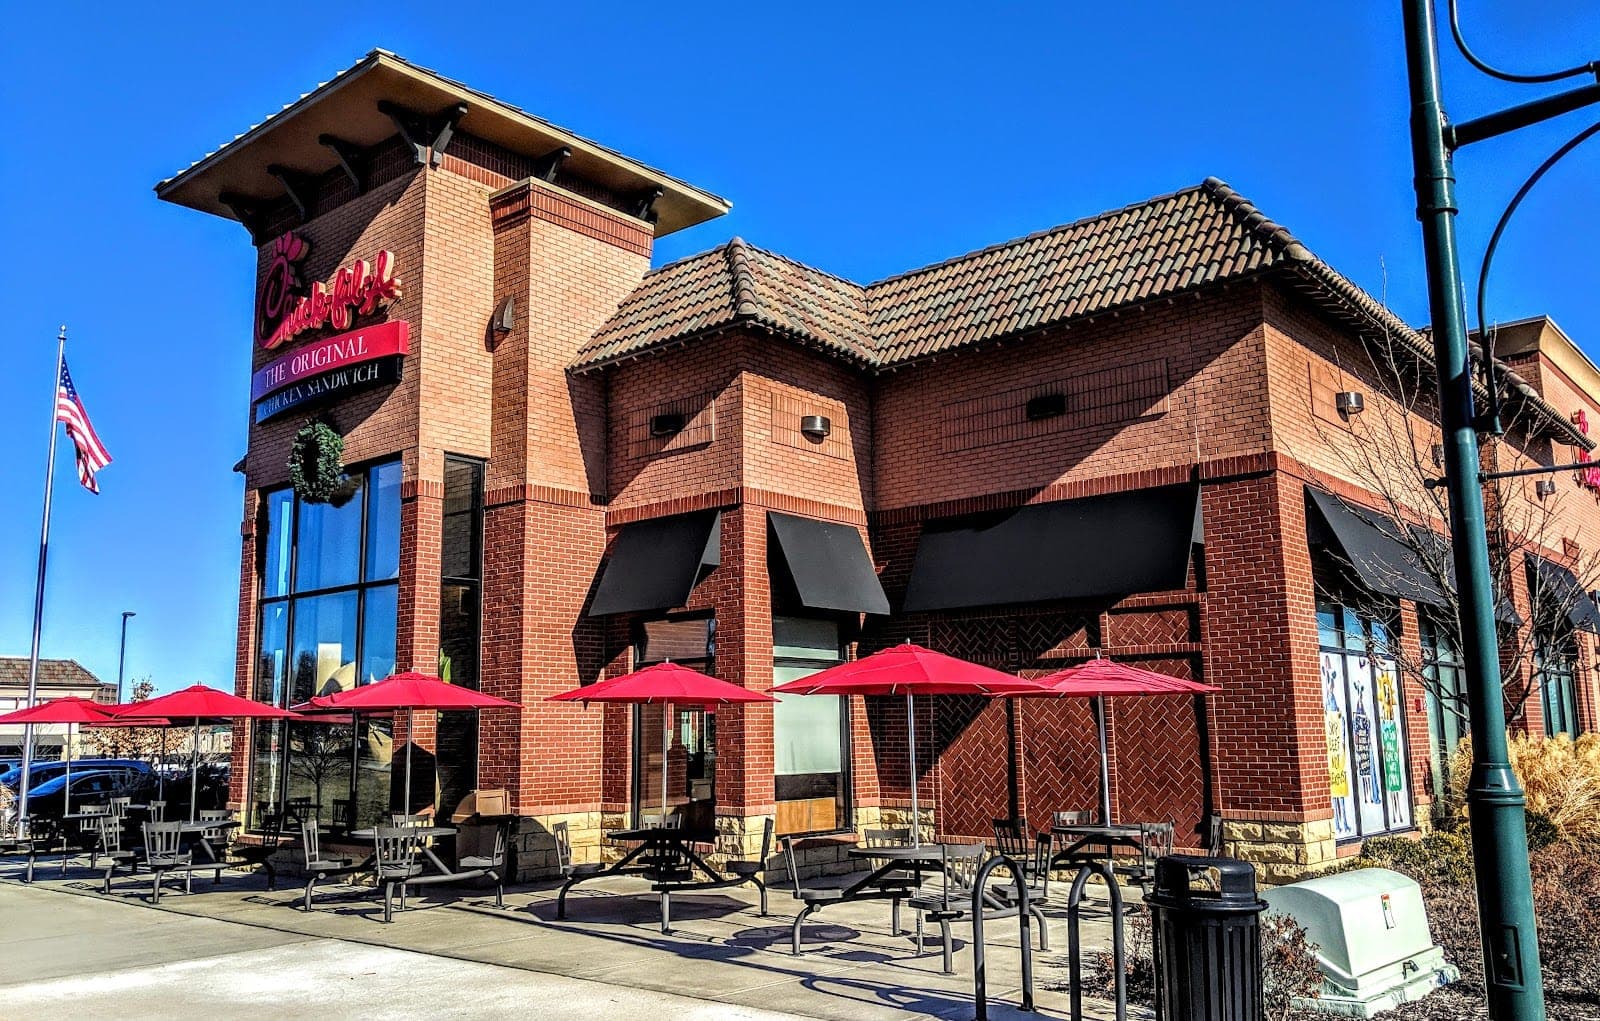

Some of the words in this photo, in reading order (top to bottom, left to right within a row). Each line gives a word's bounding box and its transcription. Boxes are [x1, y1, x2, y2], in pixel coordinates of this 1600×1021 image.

[265, 362, 286, 388] THE
[292, 336, 368, 375] ORIGINAL
[263, 384, 303, 416] CHICKEN
[307, 364, 379, 396] SANDWICH
